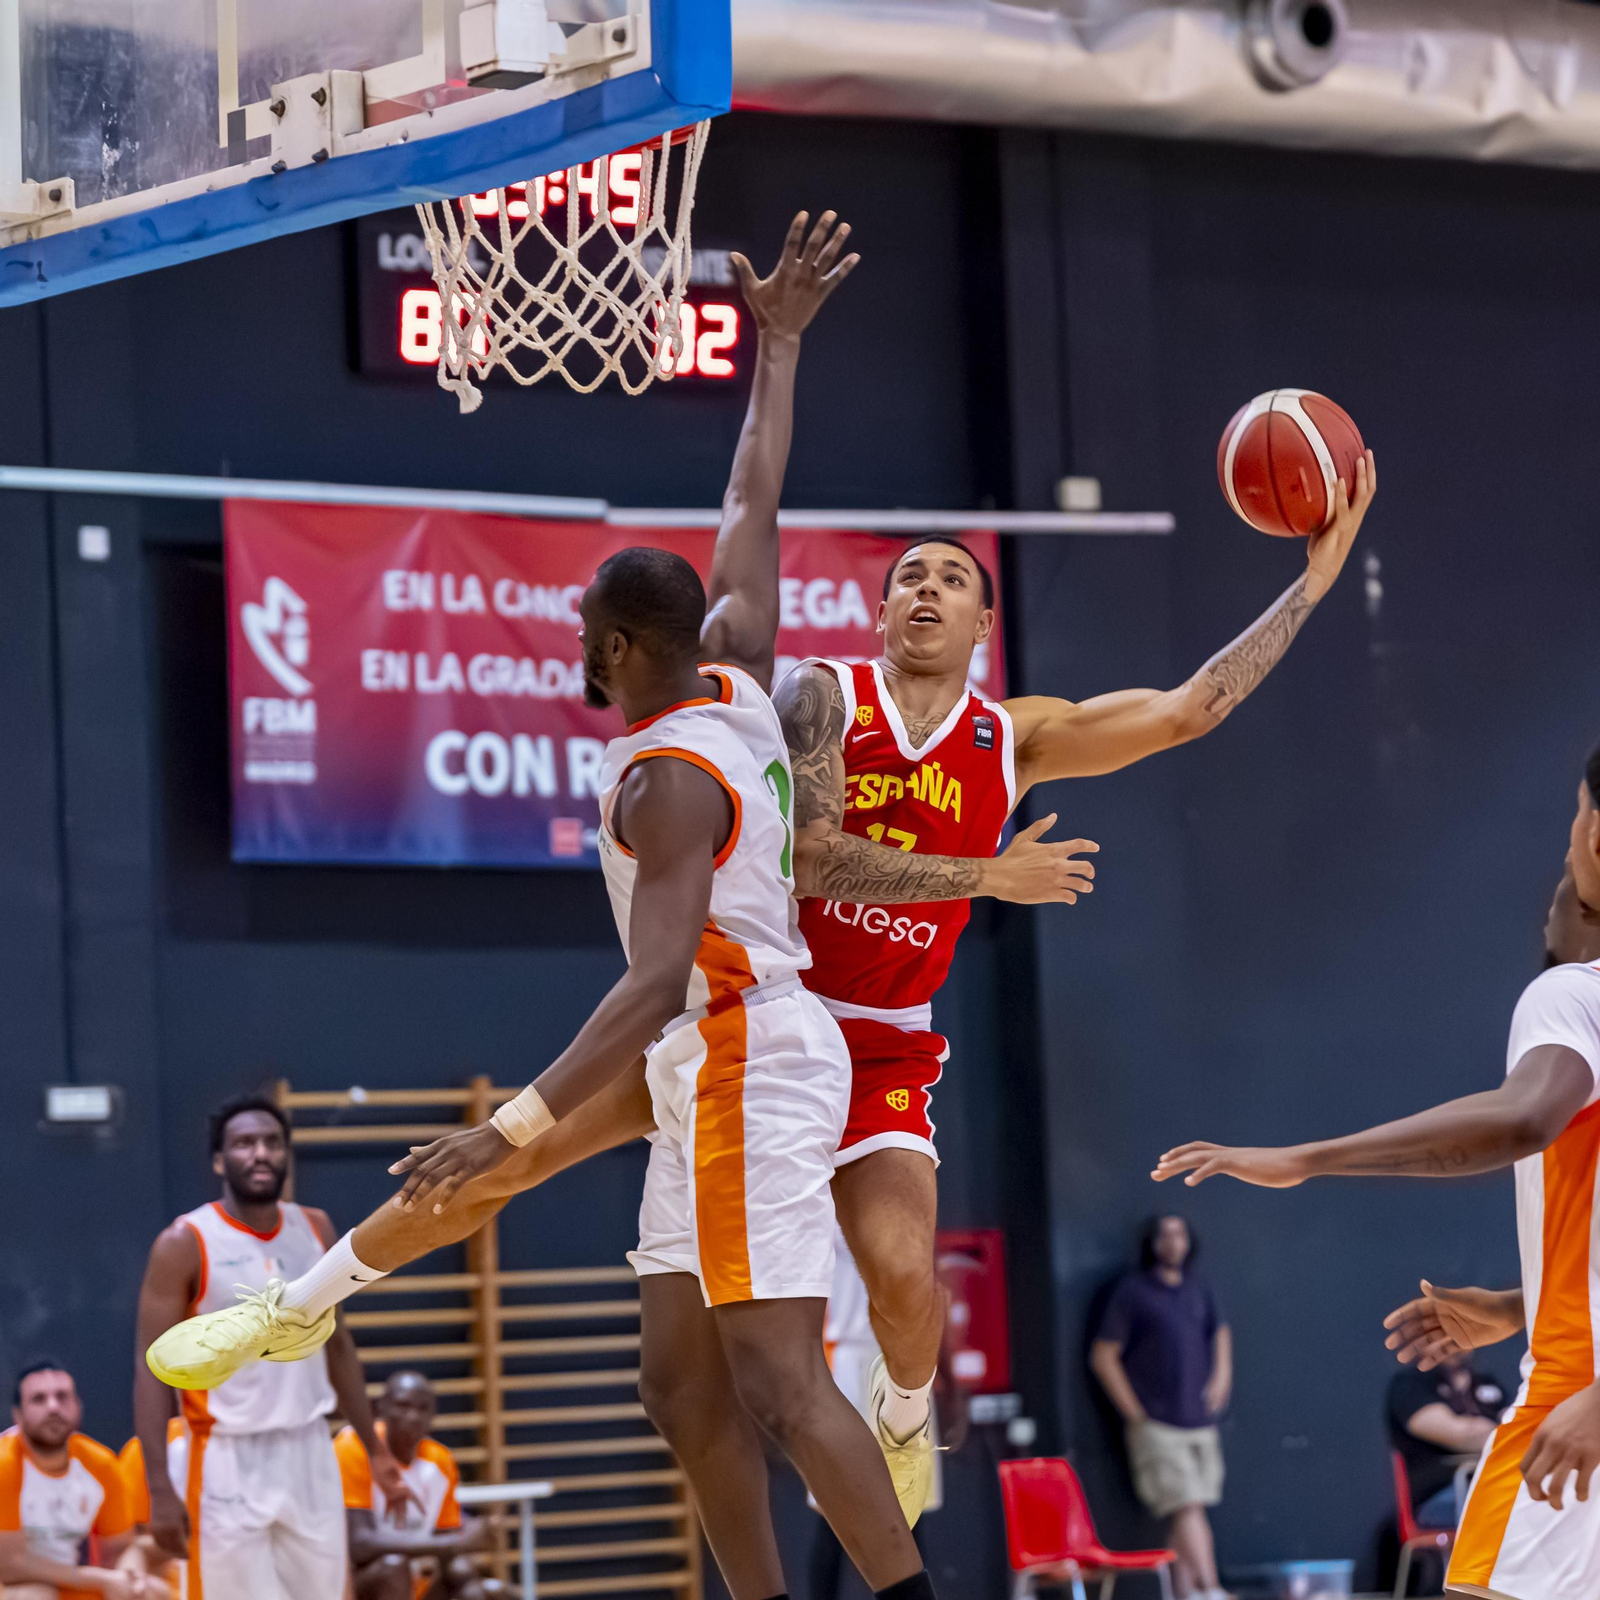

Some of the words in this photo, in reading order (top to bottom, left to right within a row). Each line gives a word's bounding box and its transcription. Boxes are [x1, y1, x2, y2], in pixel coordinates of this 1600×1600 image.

[383, 569, 434, 611] EN
[441, 571, 486, 614] LA
[493, 577, 585, 626] CANC
[779, 577, 871, 629] EGA
[361, 649, 410, 690] EN
[414, 651, 465, 694] LA
[424, 728, 557, 797] CON
